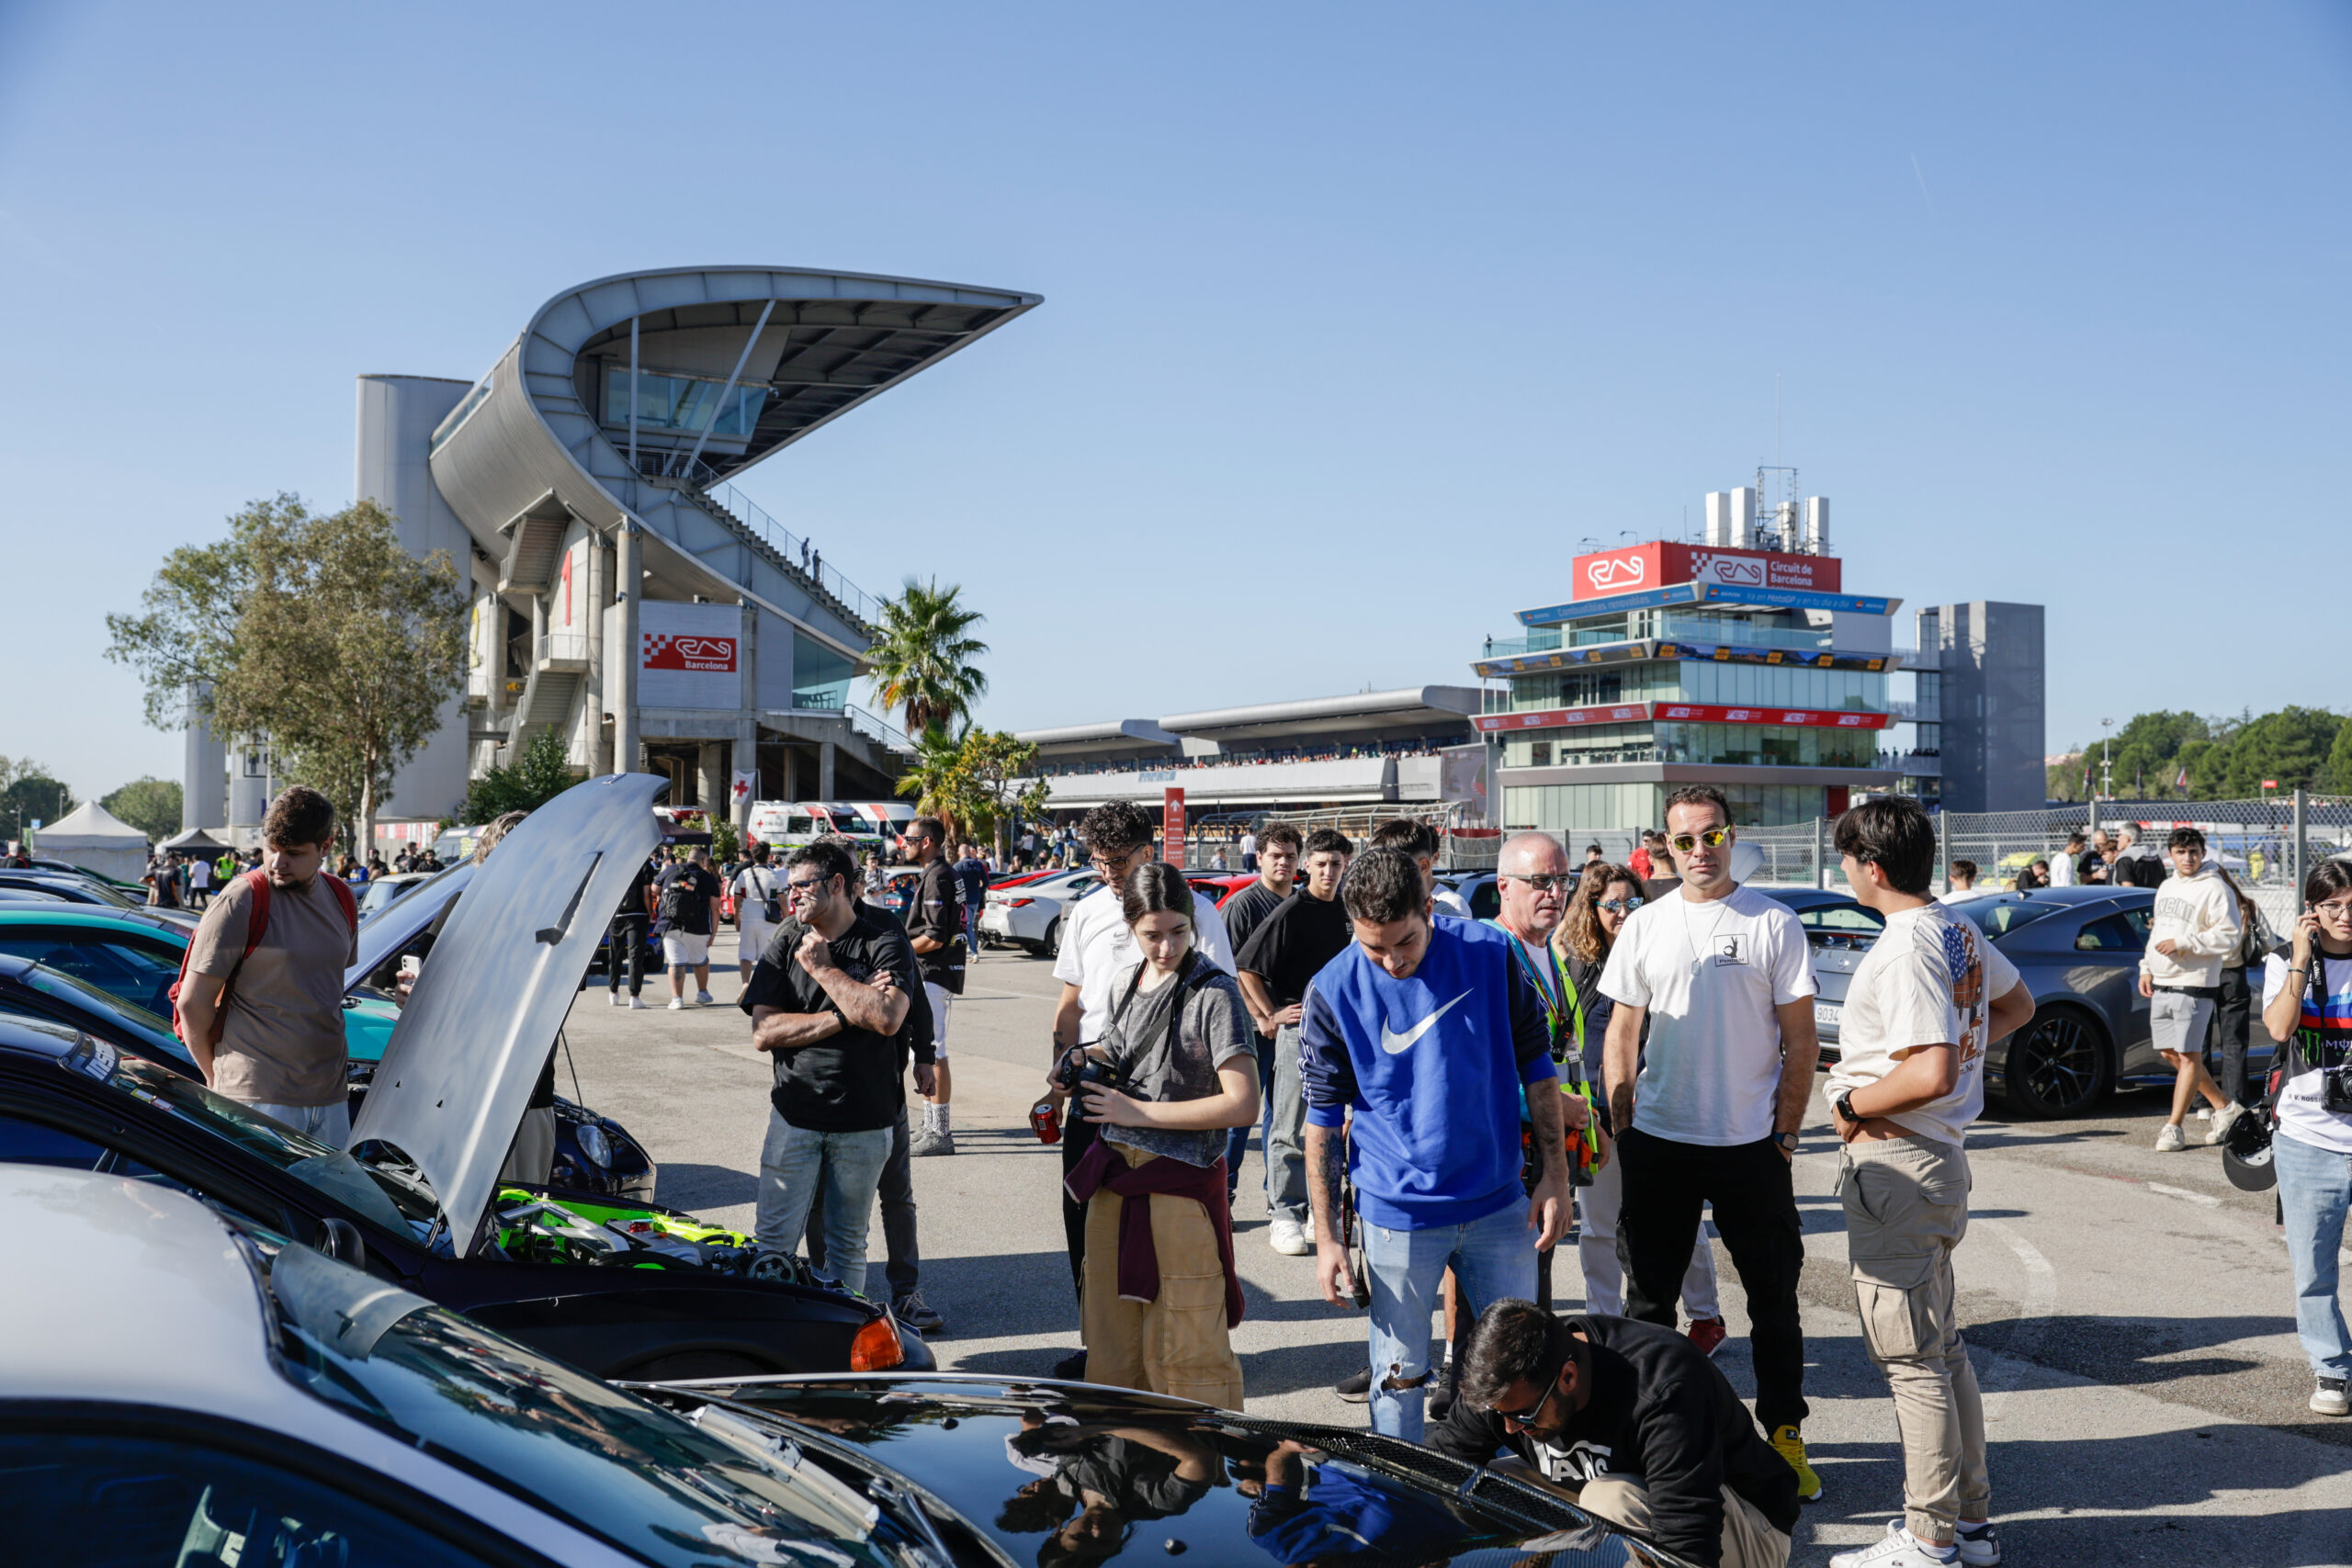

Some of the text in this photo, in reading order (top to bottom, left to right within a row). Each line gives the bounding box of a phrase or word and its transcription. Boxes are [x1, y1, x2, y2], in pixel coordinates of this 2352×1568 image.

[1770, 561, 1813, 575] Circuit de
[1770, 573, 1813, 586] Barcelona
[684, 660, 729, 671] Barcelona
[2312, 960, 2322, 986] Canon
[2301, 1095, 2321, 1103] ROSSI
[1532, 1439, 1611, 1482] VANS
